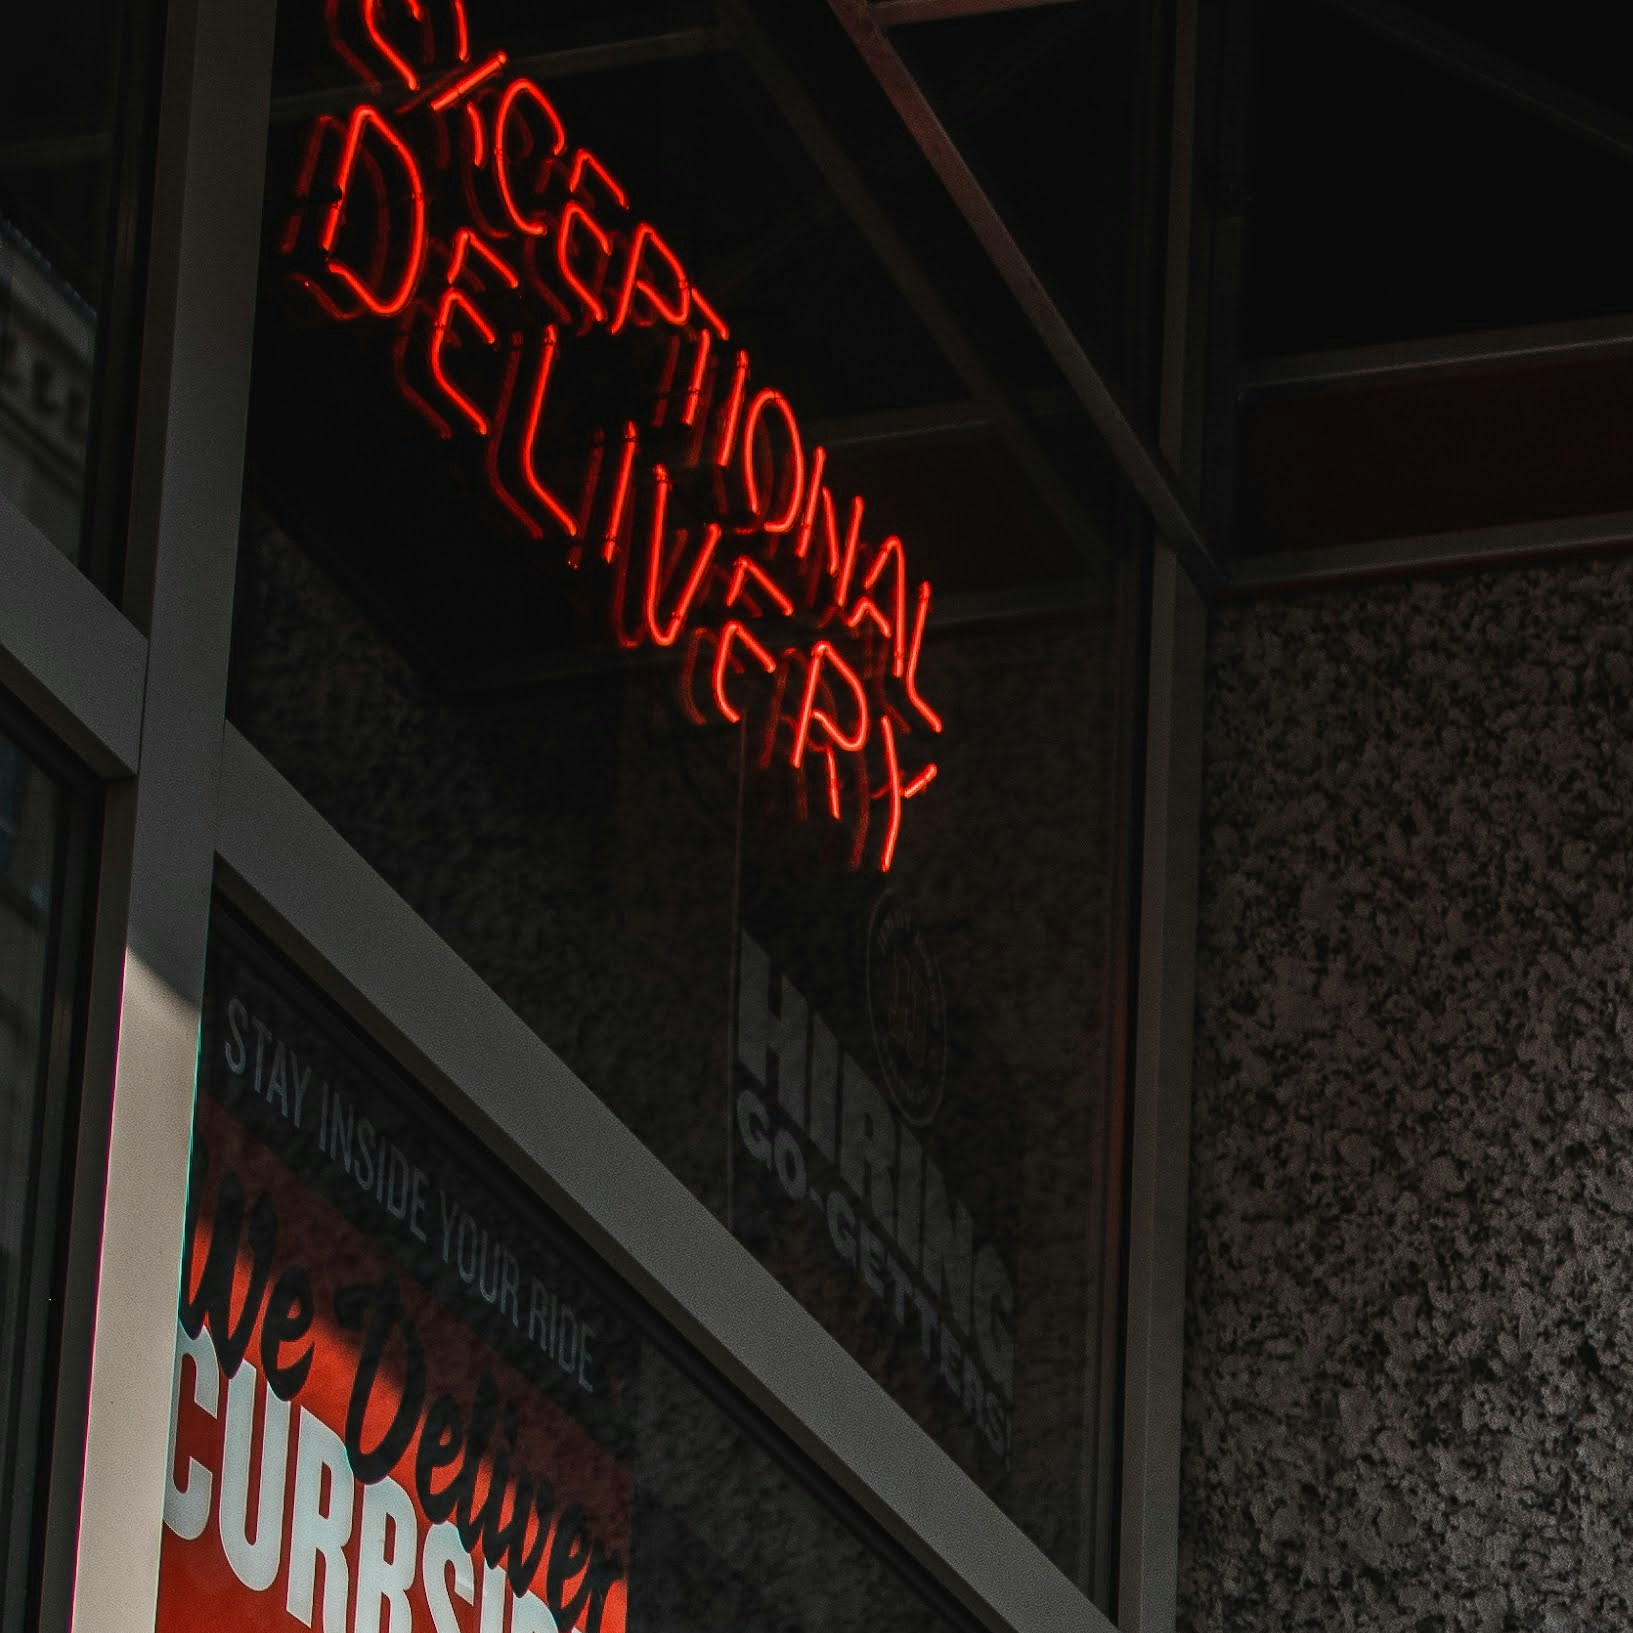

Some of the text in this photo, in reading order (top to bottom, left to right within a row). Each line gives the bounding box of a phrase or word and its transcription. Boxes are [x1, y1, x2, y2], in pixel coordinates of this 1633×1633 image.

[321, 104, 938, 873] DELIVERY
[180, 1122, 315, 1402] We
[224, 998, 595, 1393] STAY INSIDE YOUR RIDE
